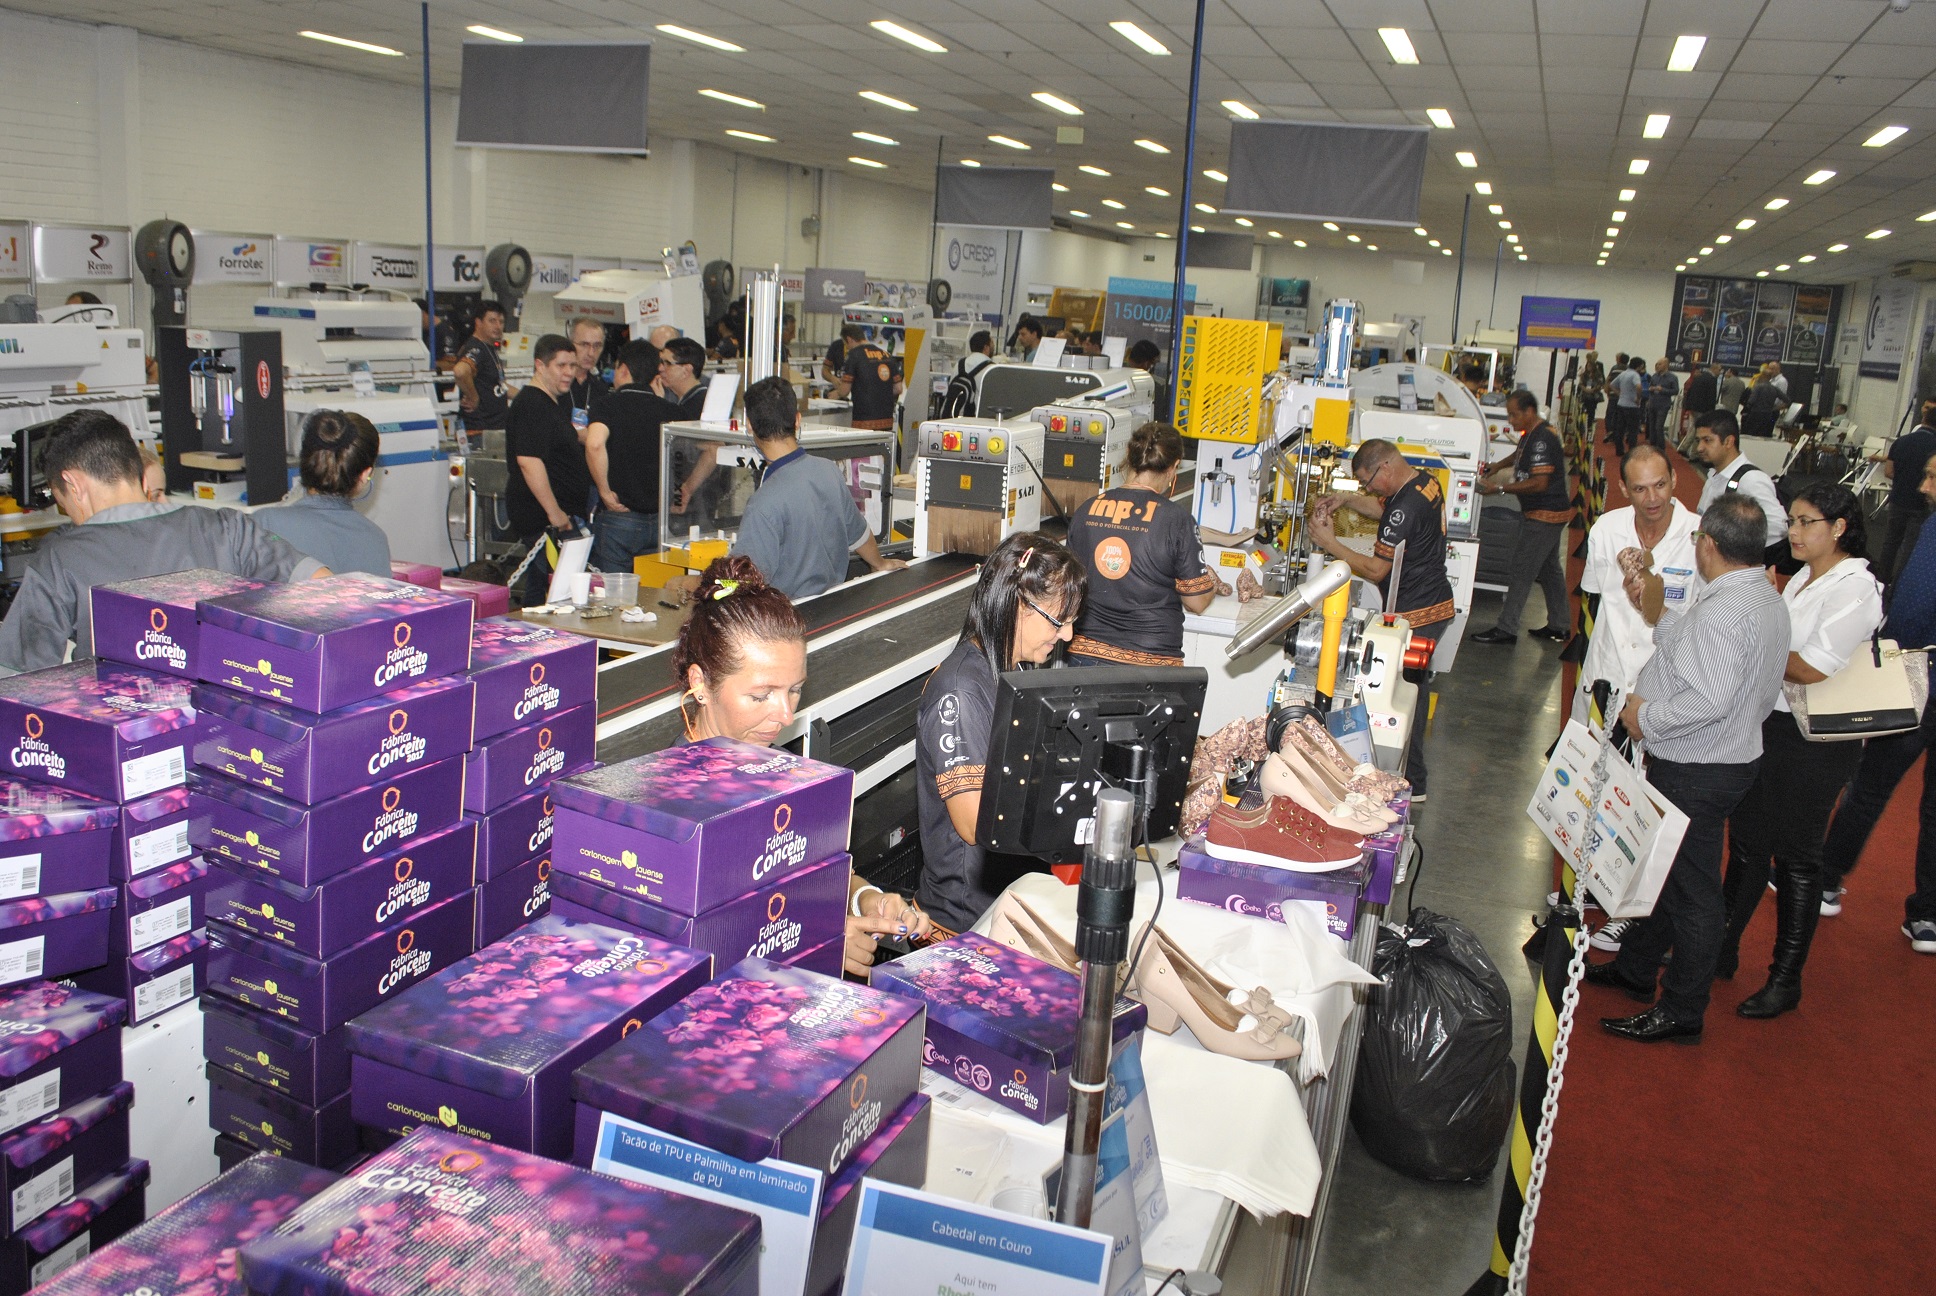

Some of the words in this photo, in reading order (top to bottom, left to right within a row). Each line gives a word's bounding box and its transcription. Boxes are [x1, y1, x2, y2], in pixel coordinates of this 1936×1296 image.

[962, 243, 997, 262] CRESPI
[87, 260, 113, 271] Remo
[453, 254, 480, 281] fcc
[822, 280, 846, 297] fcc
[1104, 523, 1131, 532] POTENCIAL
[1222, 551, 1244, 560] ATENÇÃO
[145, 630, 172, 645] Fábrica
[135, 640, 187, 660] Conceito
[386, 645, 415, 665] Fábrica
[169, 658, 187, 669] 2017
[222, 658, 259, 674] cartonagem
[269, 672, 294, 684] jauense
[374, 650, 428, 687] Conceito
[409, 665, 427, 678] 2017
[524, 683, 549, 700] Fábrica
[513, 687, 560, 721] Conceito
[543, 699, 559, 711] 2017
[21, 736, 49, 753] Fábrica
[381, 731, 412, 752] Fábrica
[11, 747, 66, 769] Conceito
[217, 745, 252, 762] cartonagem
[261, 760, 284, 774] jauense
[367, 736, 426, 775] Conceito
[406, 749, 425, 763] 2017
[533, 746, 555, 766] Fábrica
[47, 767, 66, 779] 2017
[524, 750, 565, 786] Conceito
[550, 761, 564, 774] 2017
[375, 808, 405, 830] Fábrica
[538, 814, 554, 832] Fábri
[211, 827, 247, 844] cartonagem
[257, 841, 281, 856] jauense
[362, 812, 418, 853] Conceito
[398, 825, 417, 839] 2017
[765, 829, 794, 853] Fábrica
[579, 848, 622, 867] cartonagem
[636, 864, 664, 880] jauense
[752, 835, 807, 881] Conceito
[787, 850, 806, 867] 2017
[388, 877, 417, 900] Fábrica
[411, 892, 430, 907] 2017
[375, 880, 431, 923] Conceito
[228, 900, 263, 917] cartonagem
[273, 914, 296, 929] jauense
[747, 921, 801, 958] Conceito
[759, 917, 789, 943] Fábrica
[782, 937, 800, 953] 2017
[957, 946, 991, 963] Fábrica
[390, 948, 418, 972] Fábrica
[583, 936, 644, 979] Conceito
[612, 950, 650, 973] Fábrica
[934, 946, 1000, 973] Conceito
[378, 951, 431, 995] Conceito
[413, 961, 431, 977] 2017
[970, 964, 993, 976] 2017
[230, 975, 266, 993] cartonagem
[276, 990, 299, 1005] jauense
[800, 983, 854, 1028] Conceito
[225, 1045, 259, 1063] cartonagem
[268, 1063, 290, 1077] jauense
[1000, 1084, 1039, 1105] Conceito
[1008, 1078, 1029, 1093] Fábrica
[1024, 1100, 1038, 1110] 2017
[230, 1114, 263, 1132] cartonagem
[387, 1101, 440, 1124] cartonagem
[457, 1122, 492, 1141] jauense
[841, 1099, 869, 1138] Fábrica
[829, 1101, 881, 1174] Conceito
[863, 1119, 880, 1142] 2017
[620, 1131, 648, 1151] Tacão
[649, 1139, 662, 1153] de
[664, 1143, 684, 1161] TPU
[685, 1153, 692, 1163] e
[694, 1151, 737, 1176] Palmilha
[739, 1166, 757, 1179] em
[758, 1170, 808, 1194] laminado
[404, 1161, 466, 1190] Fábrica
[692, 1170, 706, 1183] de
[708, 1175, 723, 1189] PU
[359, 1169, 488, 1209] Conceito
[430, 1195, 475, 1216] 2017
[931, 1220, 978, 1242] Cabedal
[978, 1233, 997, 1247] em
[999, 1236, 1032, 1256] Couro
[954, 1271, 974, 1288] Aqui
[975, 1277, 997, 1292] tem
